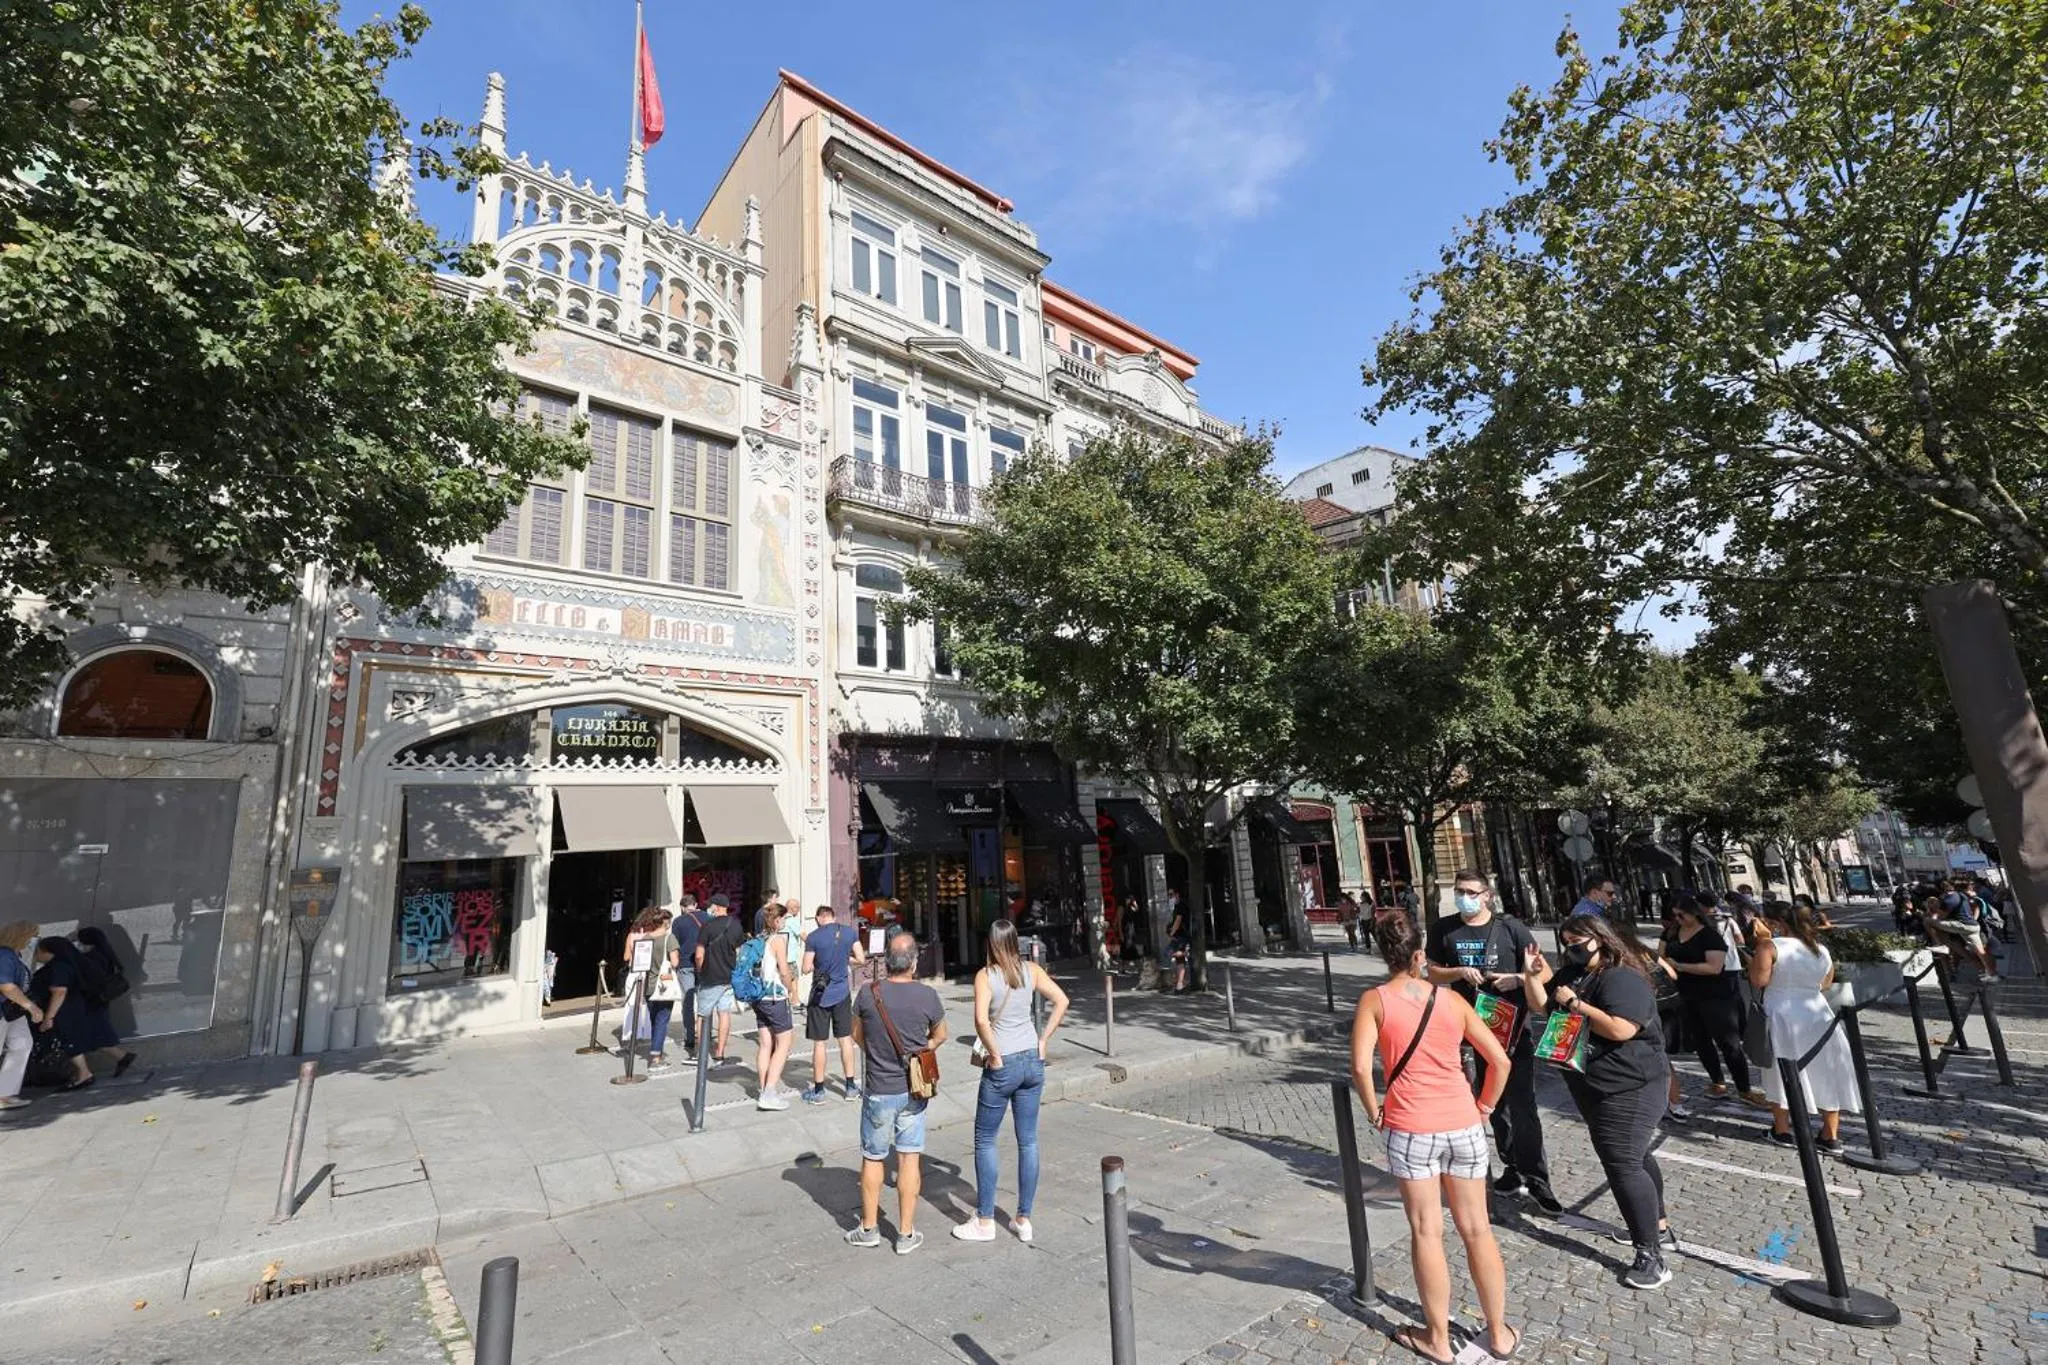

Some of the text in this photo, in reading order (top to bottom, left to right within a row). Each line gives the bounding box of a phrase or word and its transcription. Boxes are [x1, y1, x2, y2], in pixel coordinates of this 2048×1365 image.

[567, 717, 649, 732] LIVRARIA
[557, 733, 657, 748] CHARDRON
[402, 889, 495, 907] RESPIRANDO
[403, 899, 495, 919] SONHOS
[402, 907, 495, 940] EM VEZ
[401, 930, 492, 964] DE AR
